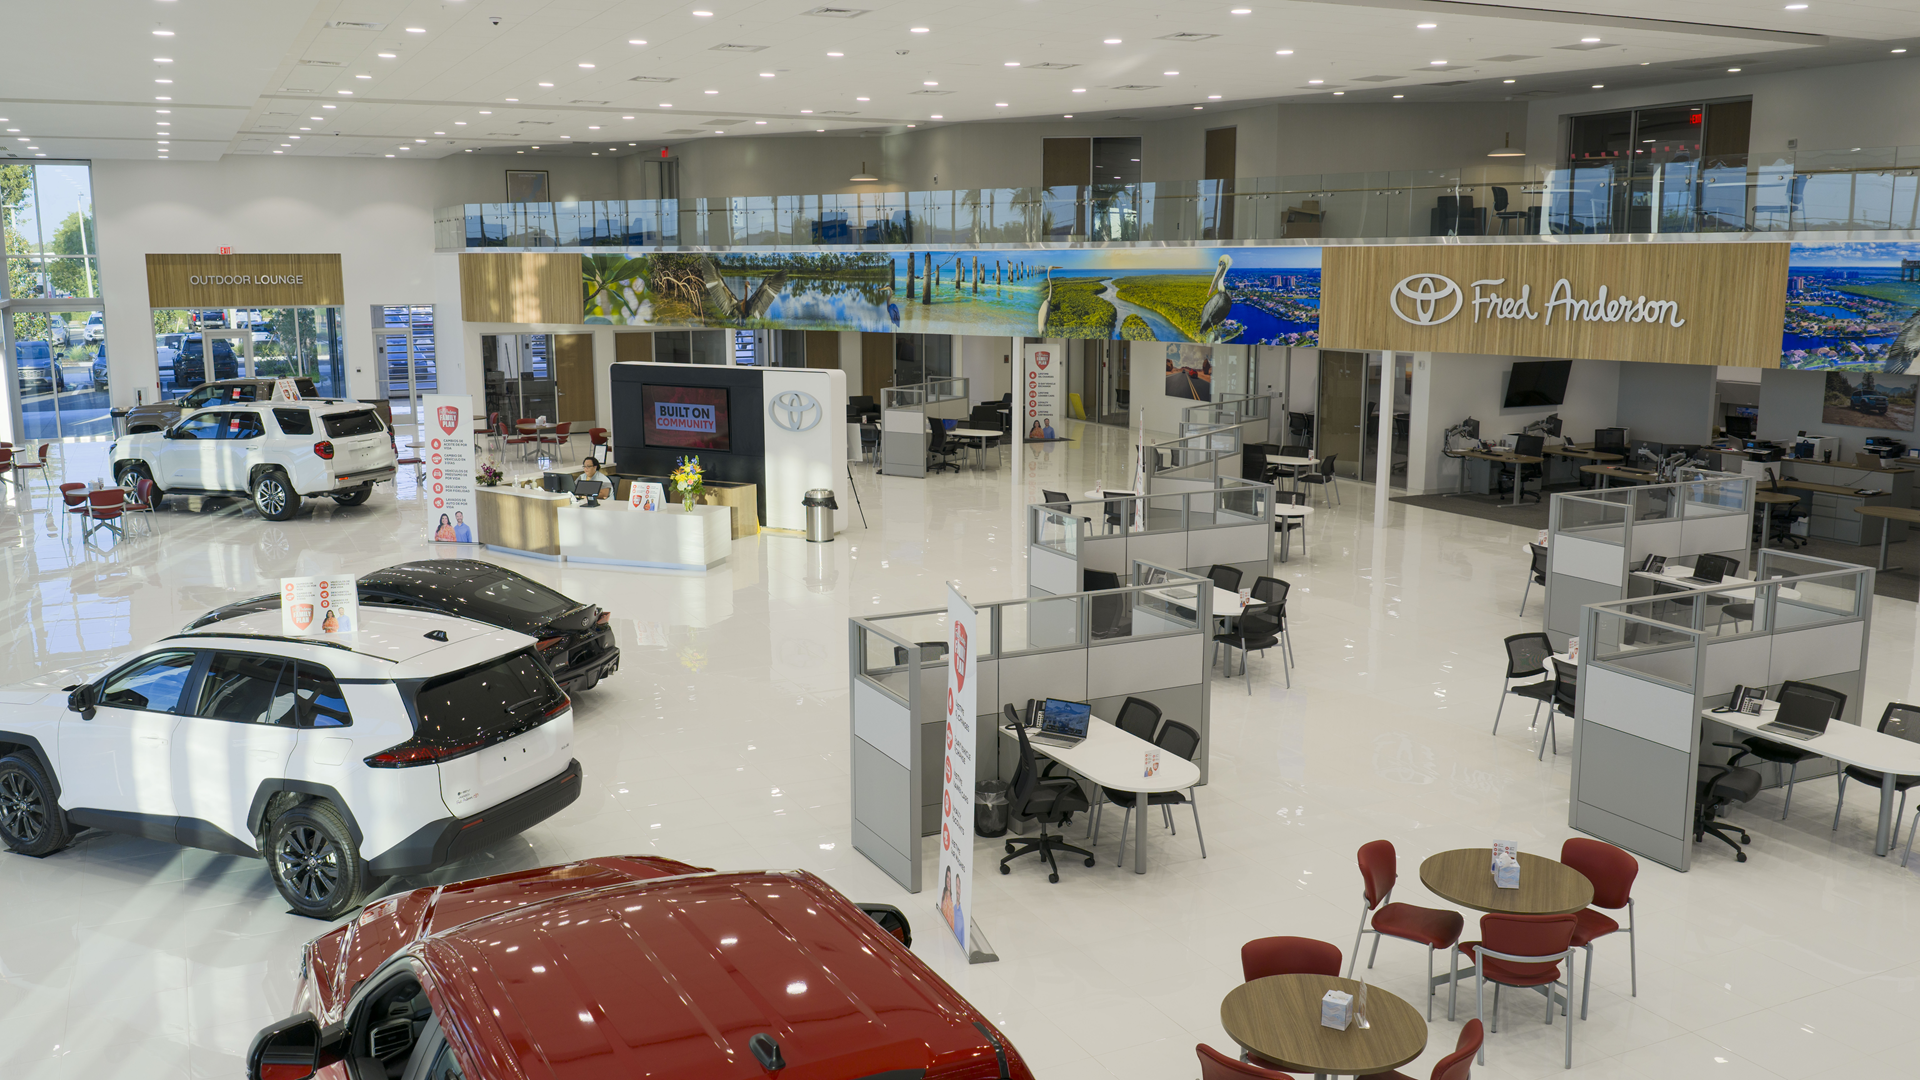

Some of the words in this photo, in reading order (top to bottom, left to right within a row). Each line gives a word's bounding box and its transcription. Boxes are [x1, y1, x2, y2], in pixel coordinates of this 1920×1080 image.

[190, 275, 251, 285] OUTDOOR
[254, 275, 304, 285] LOUNGE
[1470, 278, 1538, 324] Fred
[1544, 278, 1686, 328] Anderson
[660, 406, 690, 418] BUILT
[692, 408, 710, 419] ON
[657, 418, 714, 429] COMMUNITY
